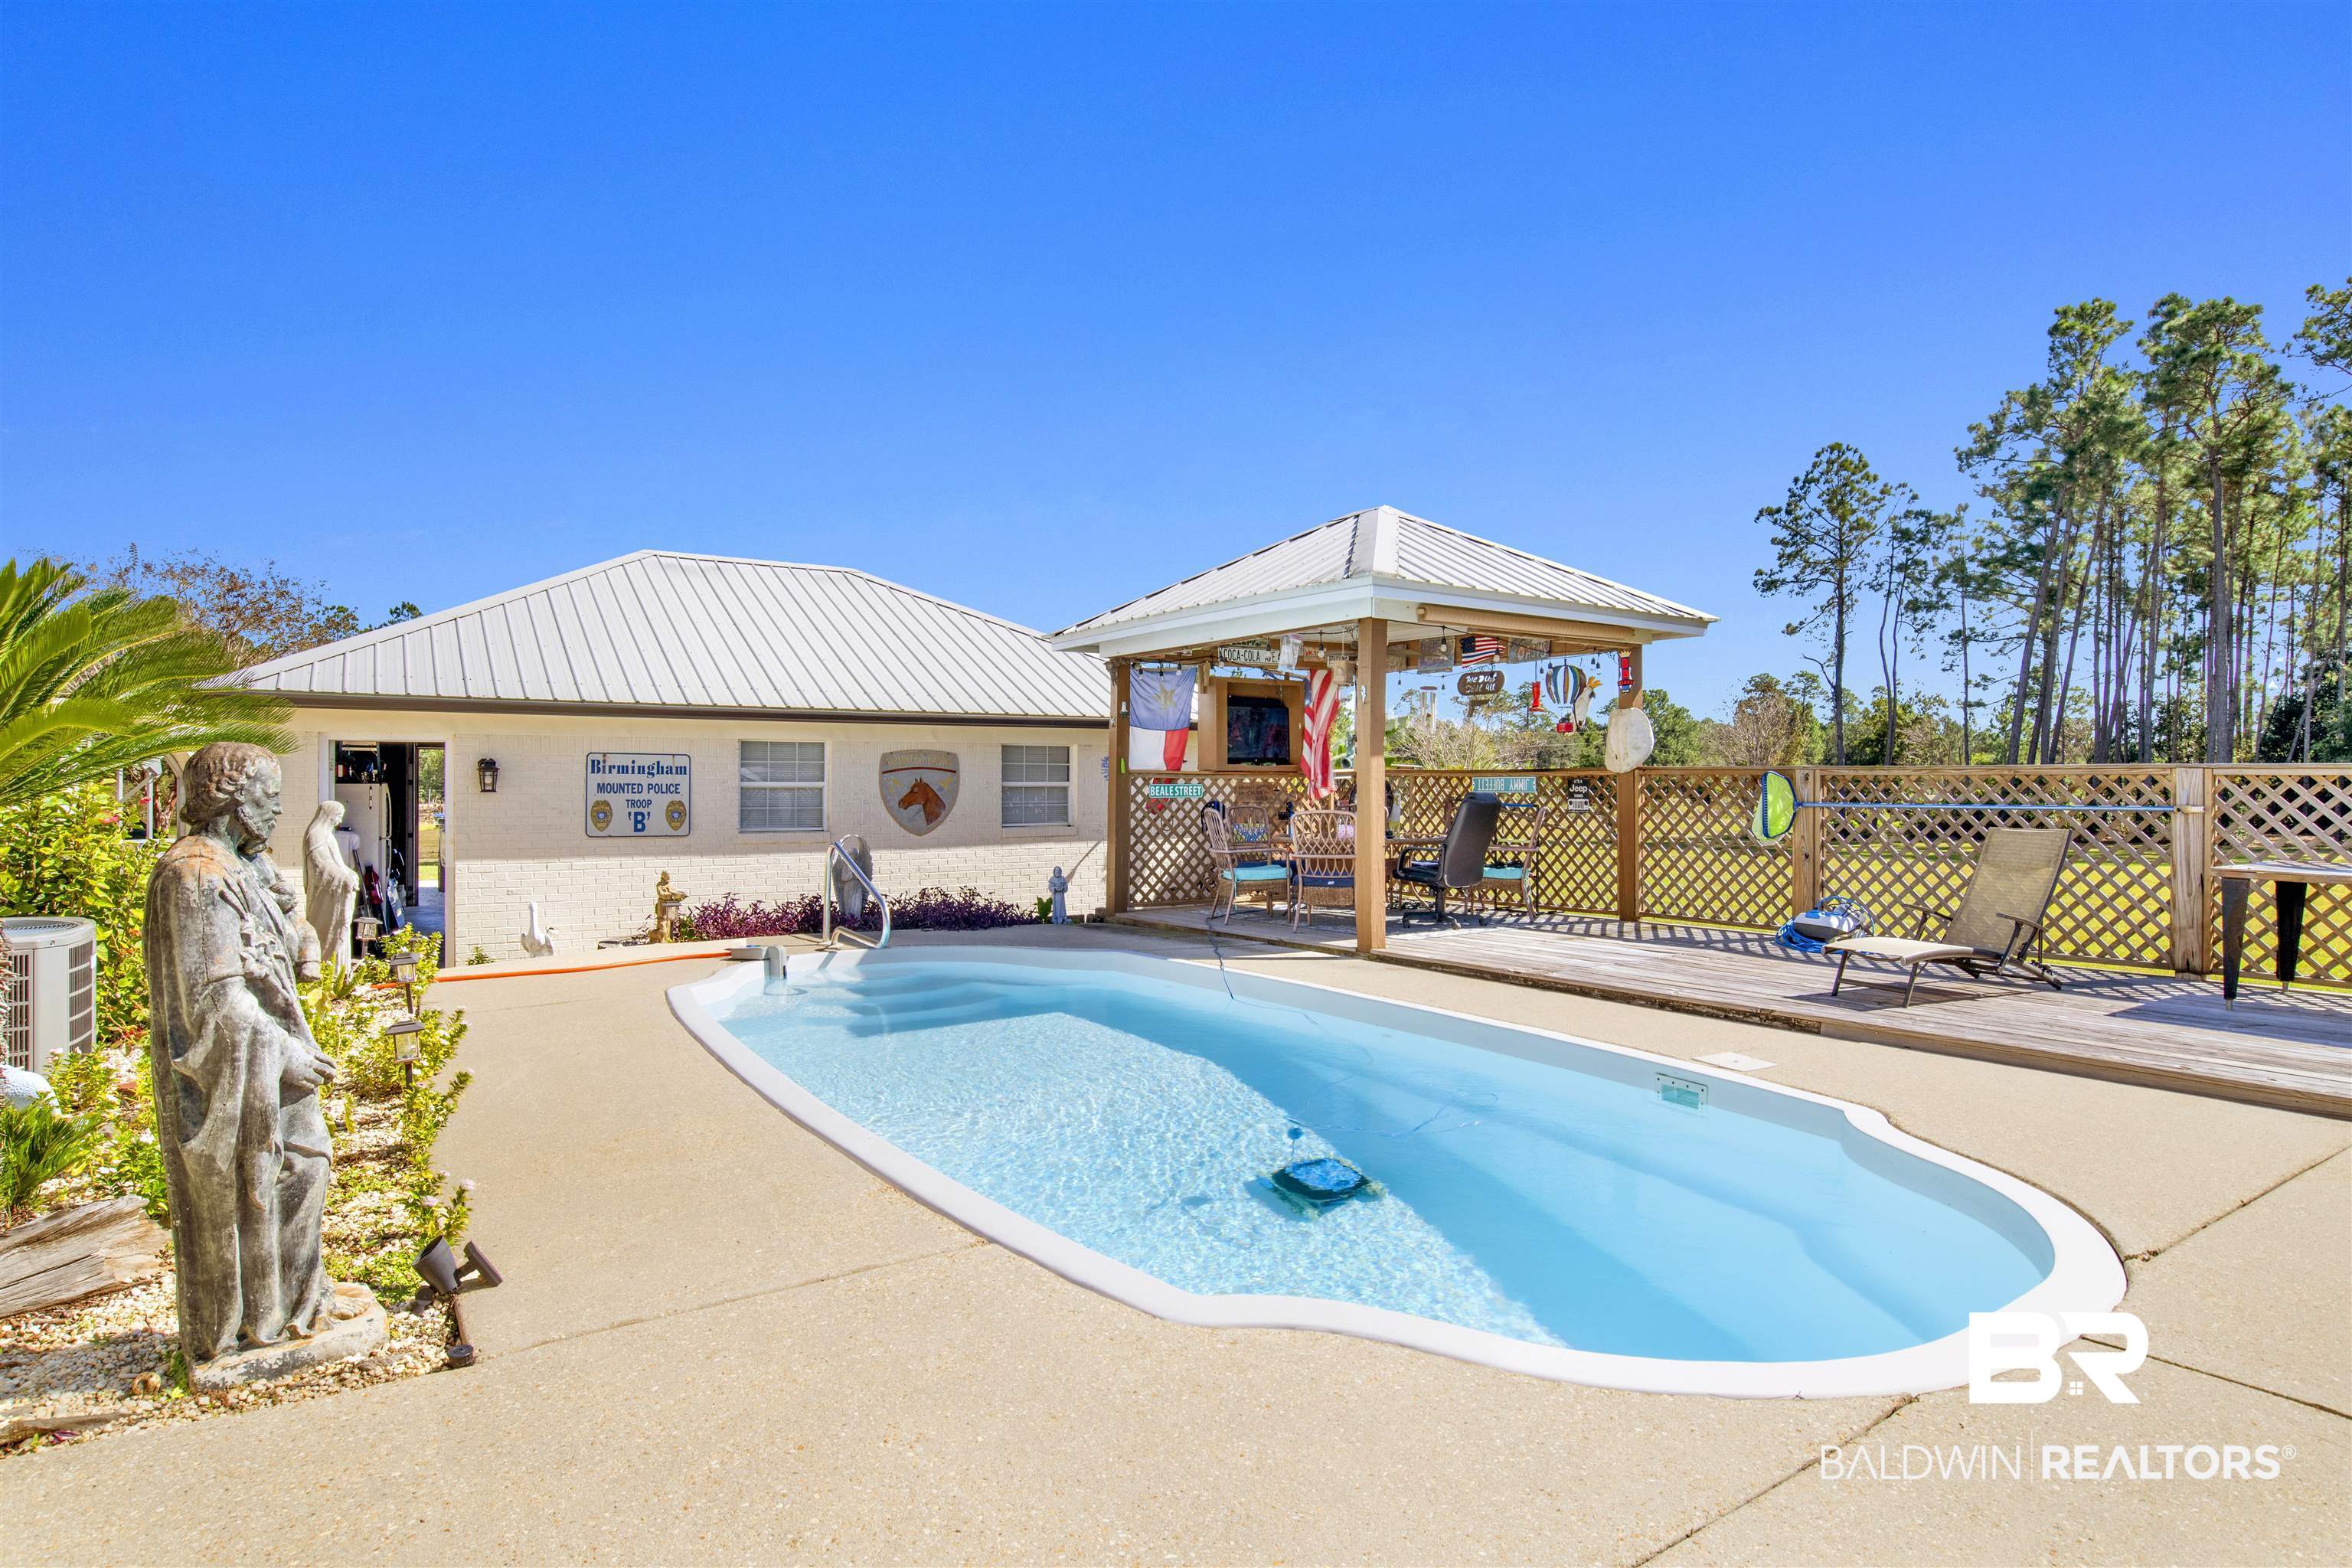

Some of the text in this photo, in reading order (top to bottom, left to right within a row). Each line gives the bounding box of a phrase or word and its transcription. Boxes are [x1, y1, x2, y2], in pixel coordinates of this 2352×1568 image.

[1223, 648, 1260, 662] COCA-COLA
[590, 759, 687, 779] Birmingham
[596, 782, 680, 794] MOUNTED POLICE
[1478, 778, 1530, 791] JIMMY BUFFETT
[1570, 784, 1588, 793] Jeep
[1150, 786, 1202, 796] BEALE STREET
[626, 799, 652, 808] TROOP
